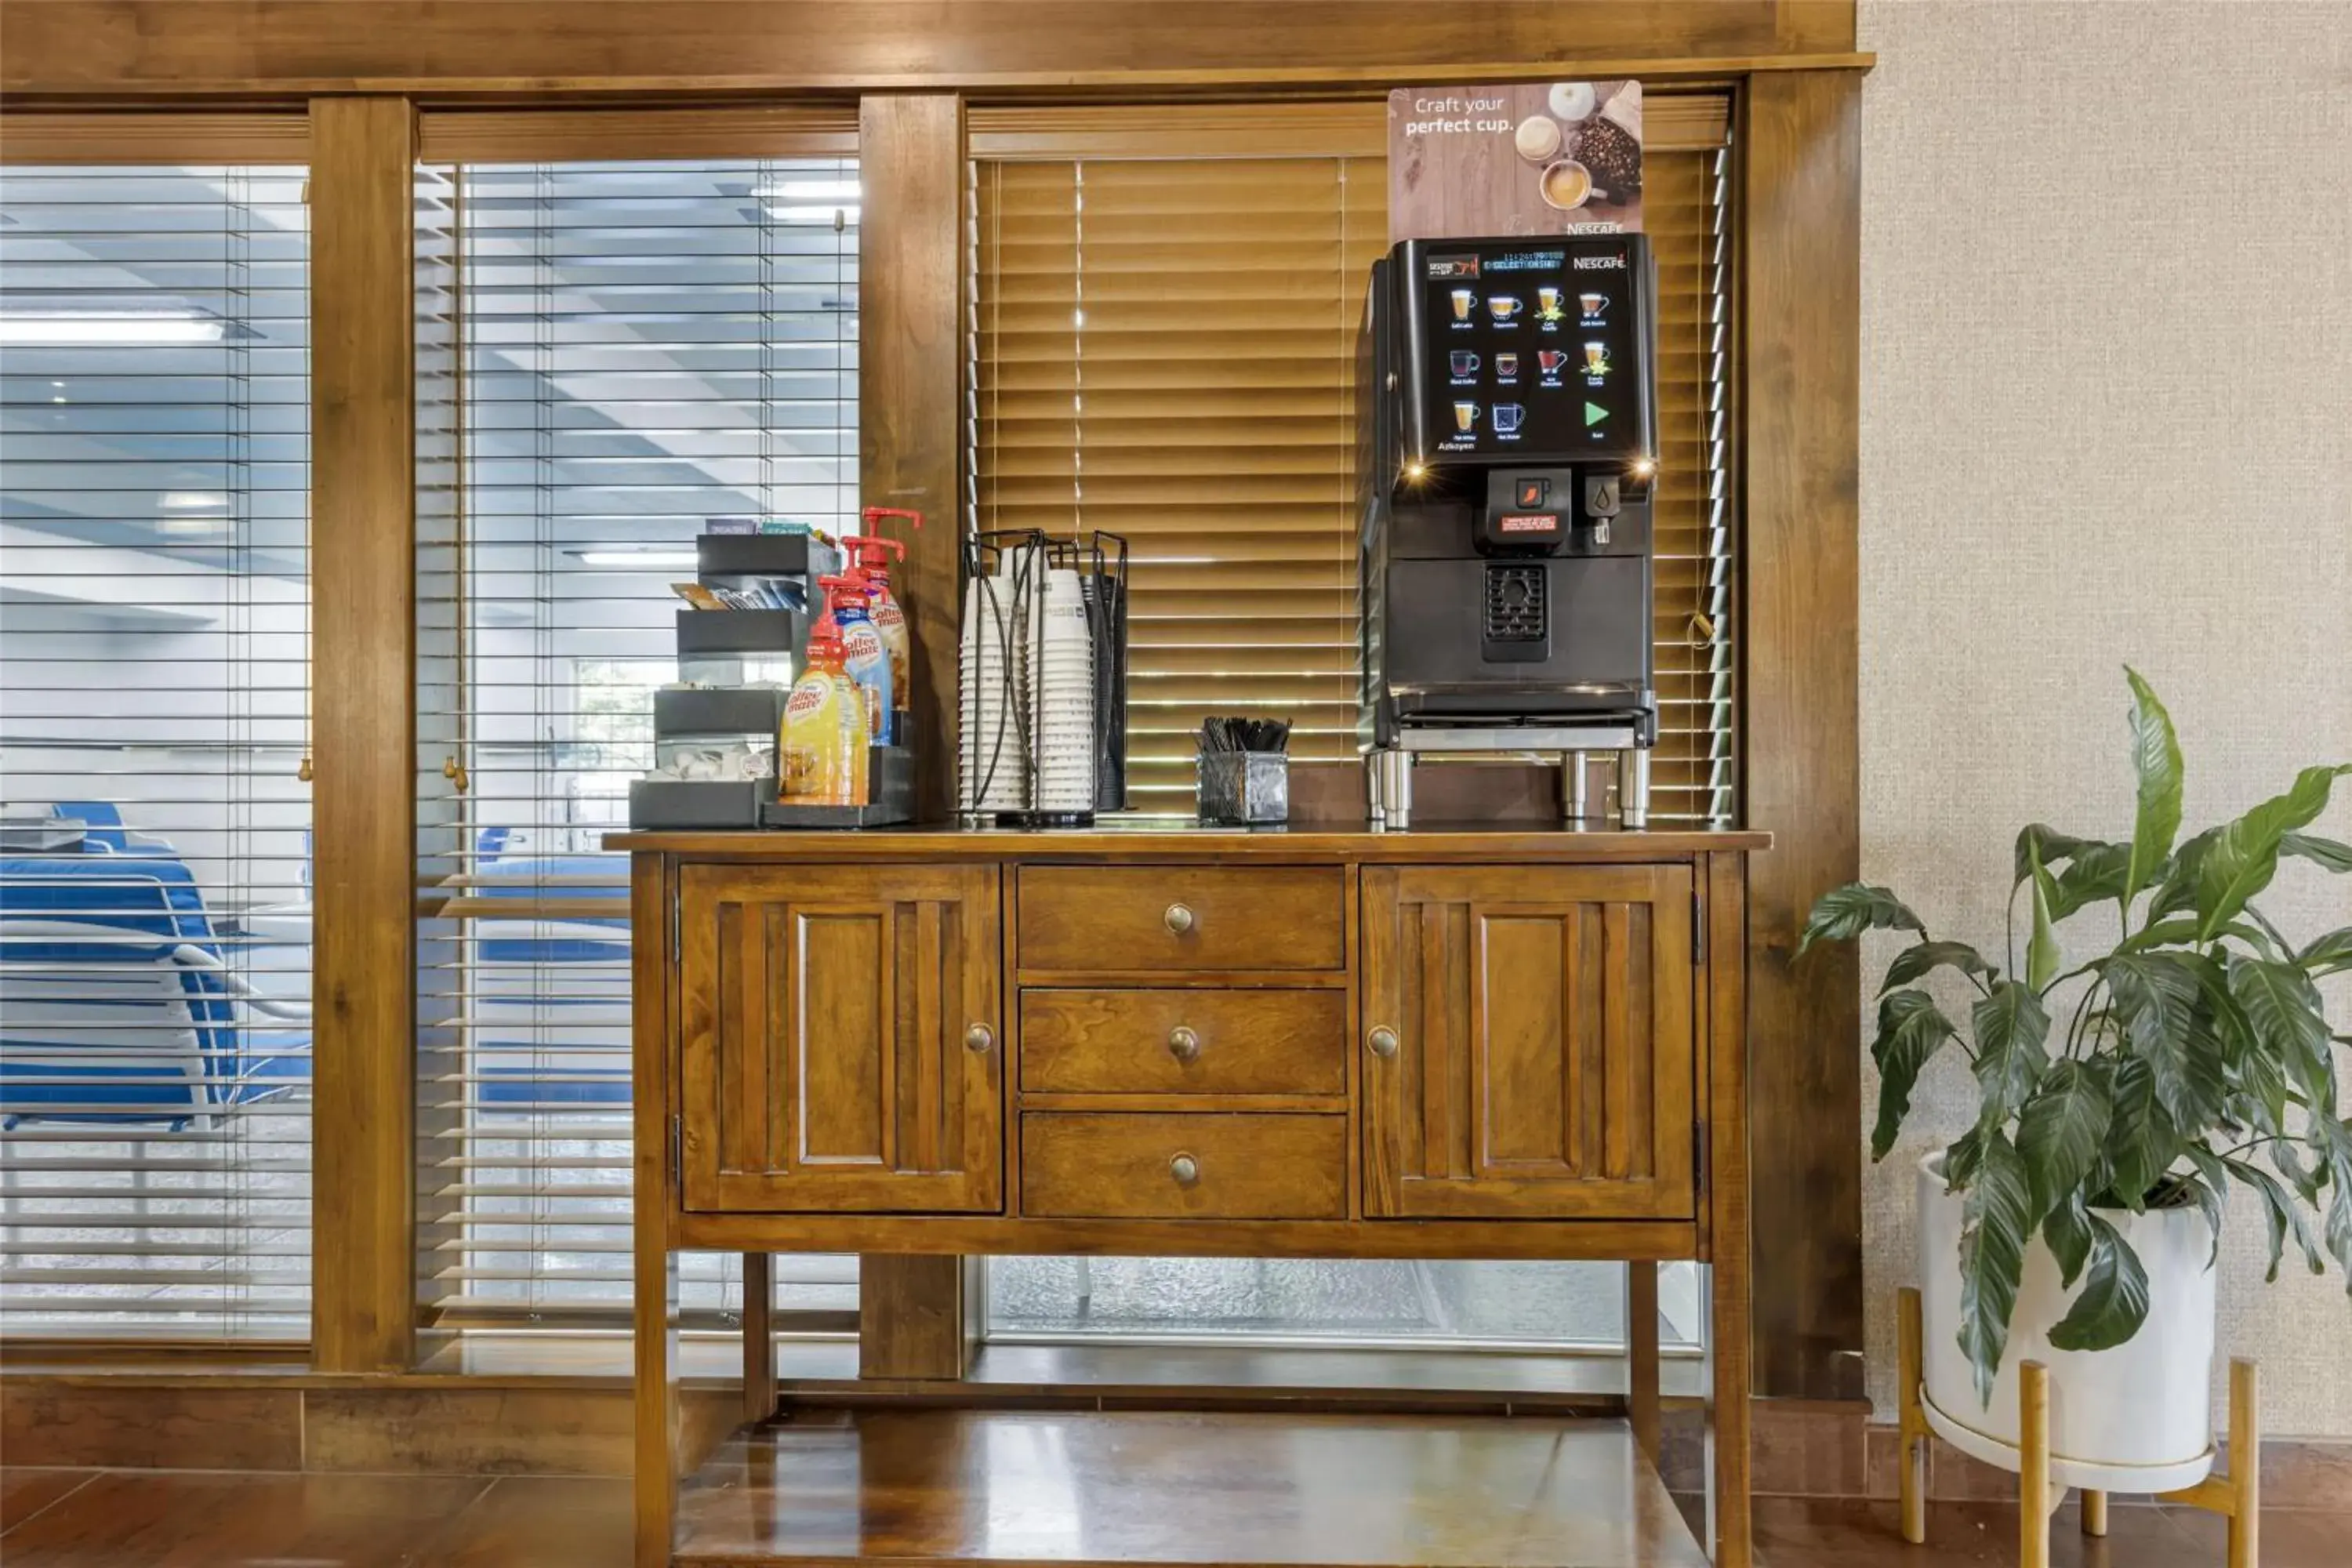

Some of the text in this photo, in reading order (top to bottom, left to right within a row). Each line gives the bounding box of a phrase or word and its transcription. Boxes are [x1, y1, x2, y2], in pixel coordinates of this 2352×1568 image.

[1415, 96, 1504, 116] Craft your
[1406, 118, 1514, 138] perfect cup.
